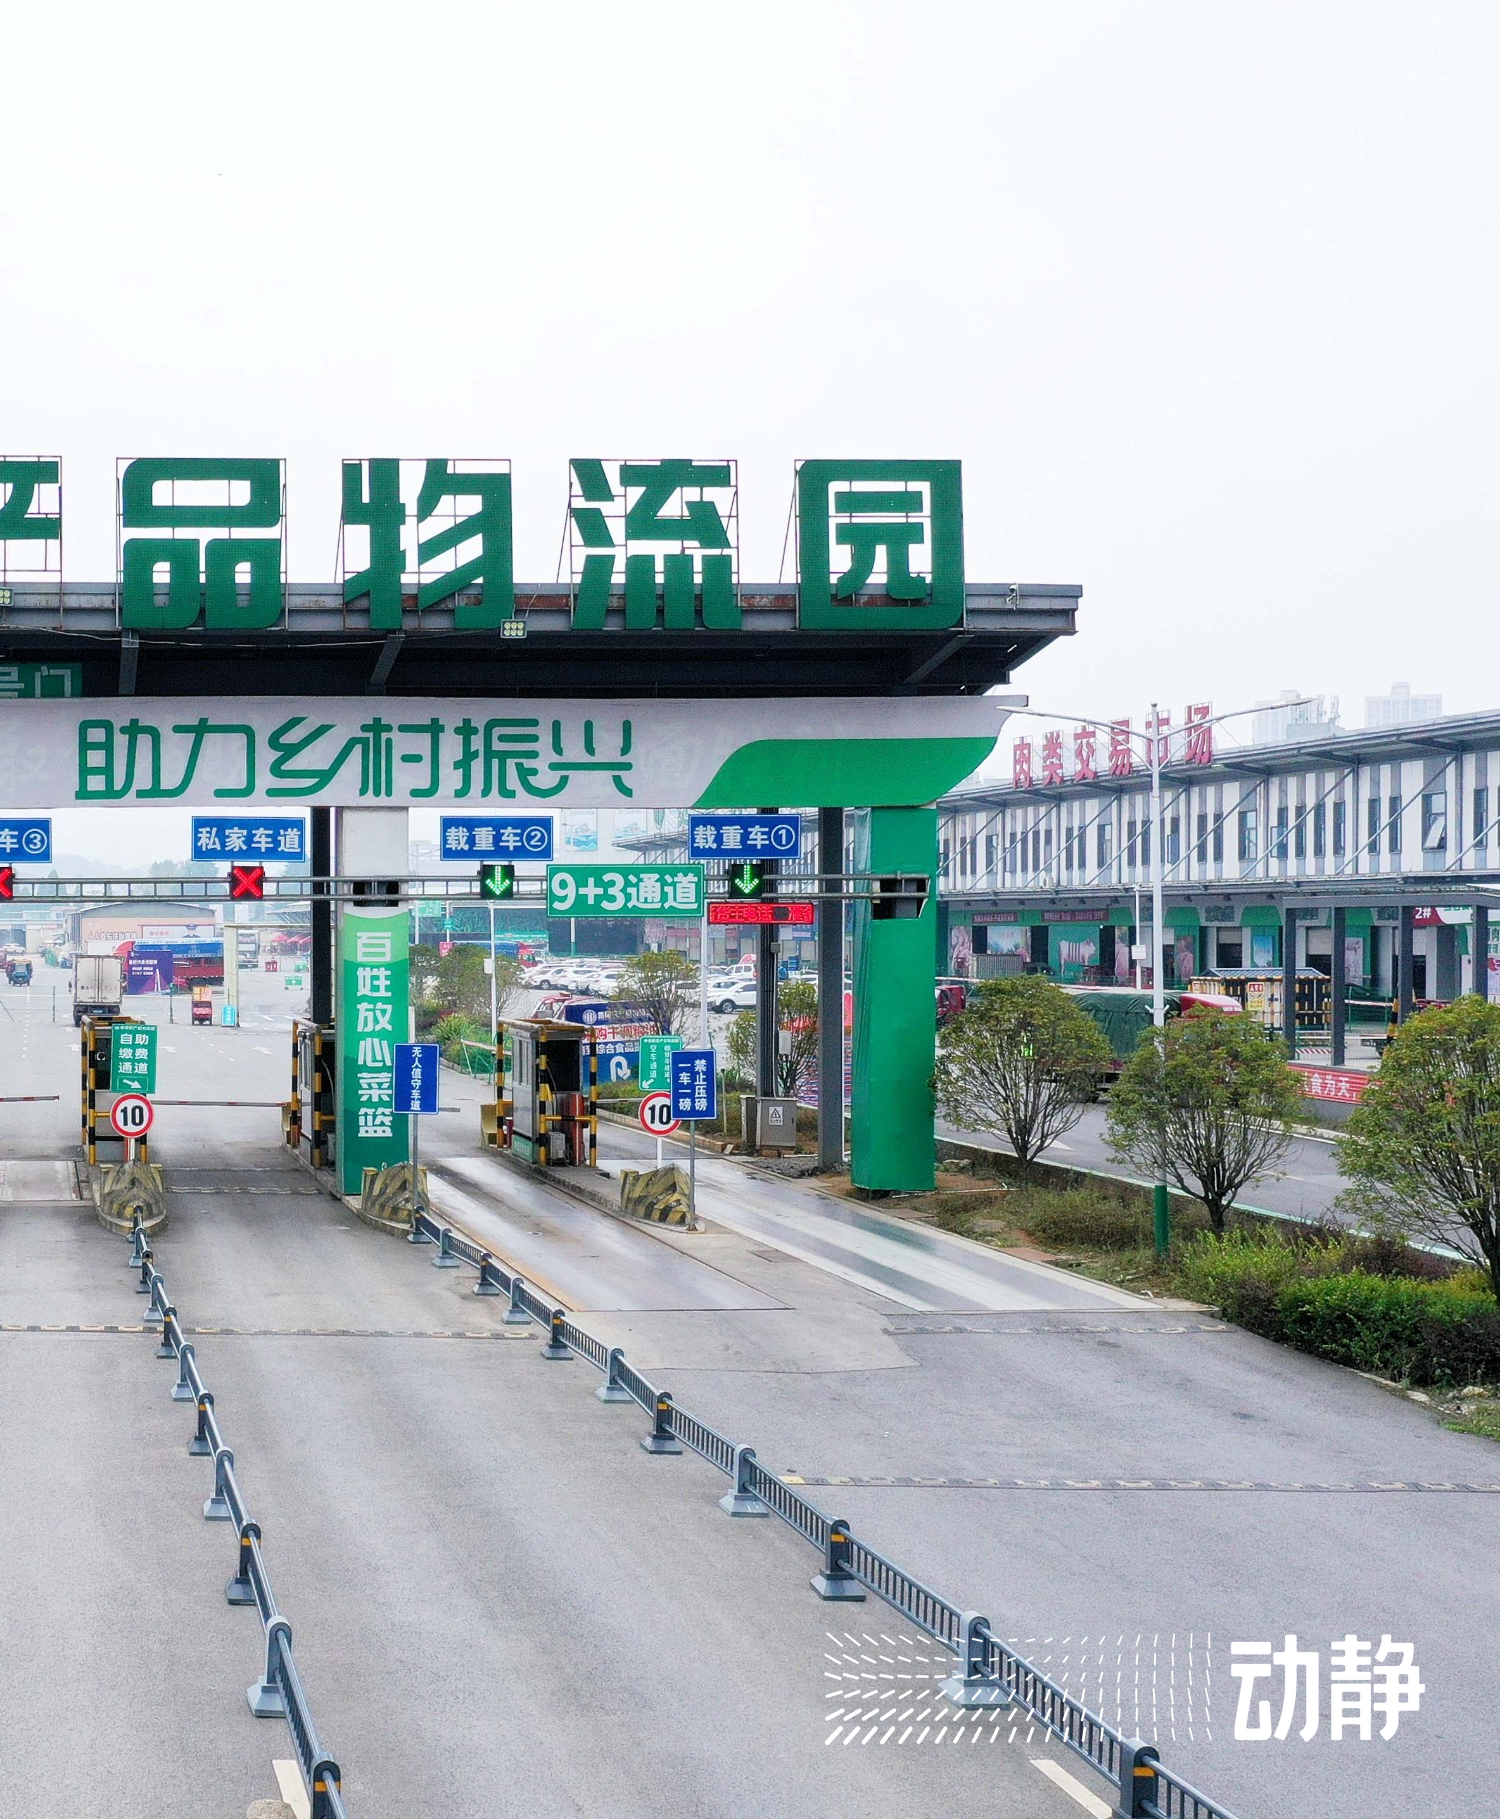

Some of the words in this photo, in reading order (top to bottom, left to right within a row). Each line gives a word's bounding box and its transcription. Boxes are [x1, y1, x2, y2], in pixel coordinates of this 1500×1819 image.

[75, 717, 634, 799] 助力乡村振兴
[1013, 704, 1214, 790] 肉类交易市场
[197, 826, 302, 854] 私家车道
[445, 825, 549, 852] 载重车②
[693, 823, 796, 850] 载重车①
[551, 871, 700, 913] 9+3通道
[1414, 906, 1432, 919] 2#
[120, 1033, 149, 1045] 自助
[356, 931, 393, 1138] 百姓放心菜篮
[118, 1048, 149, 1060] 缴费
[118, 1062, 149, 1074] 通道
[411, 1047, 423, 1112] 无人值守车道
[678, 1063, 692, 1111] 一车一磅
[694, 1059, 707, 1111] 禁止压磅
[120, 1104, 144, 1127] 10
[648, 1103, 671, 1126] 10
